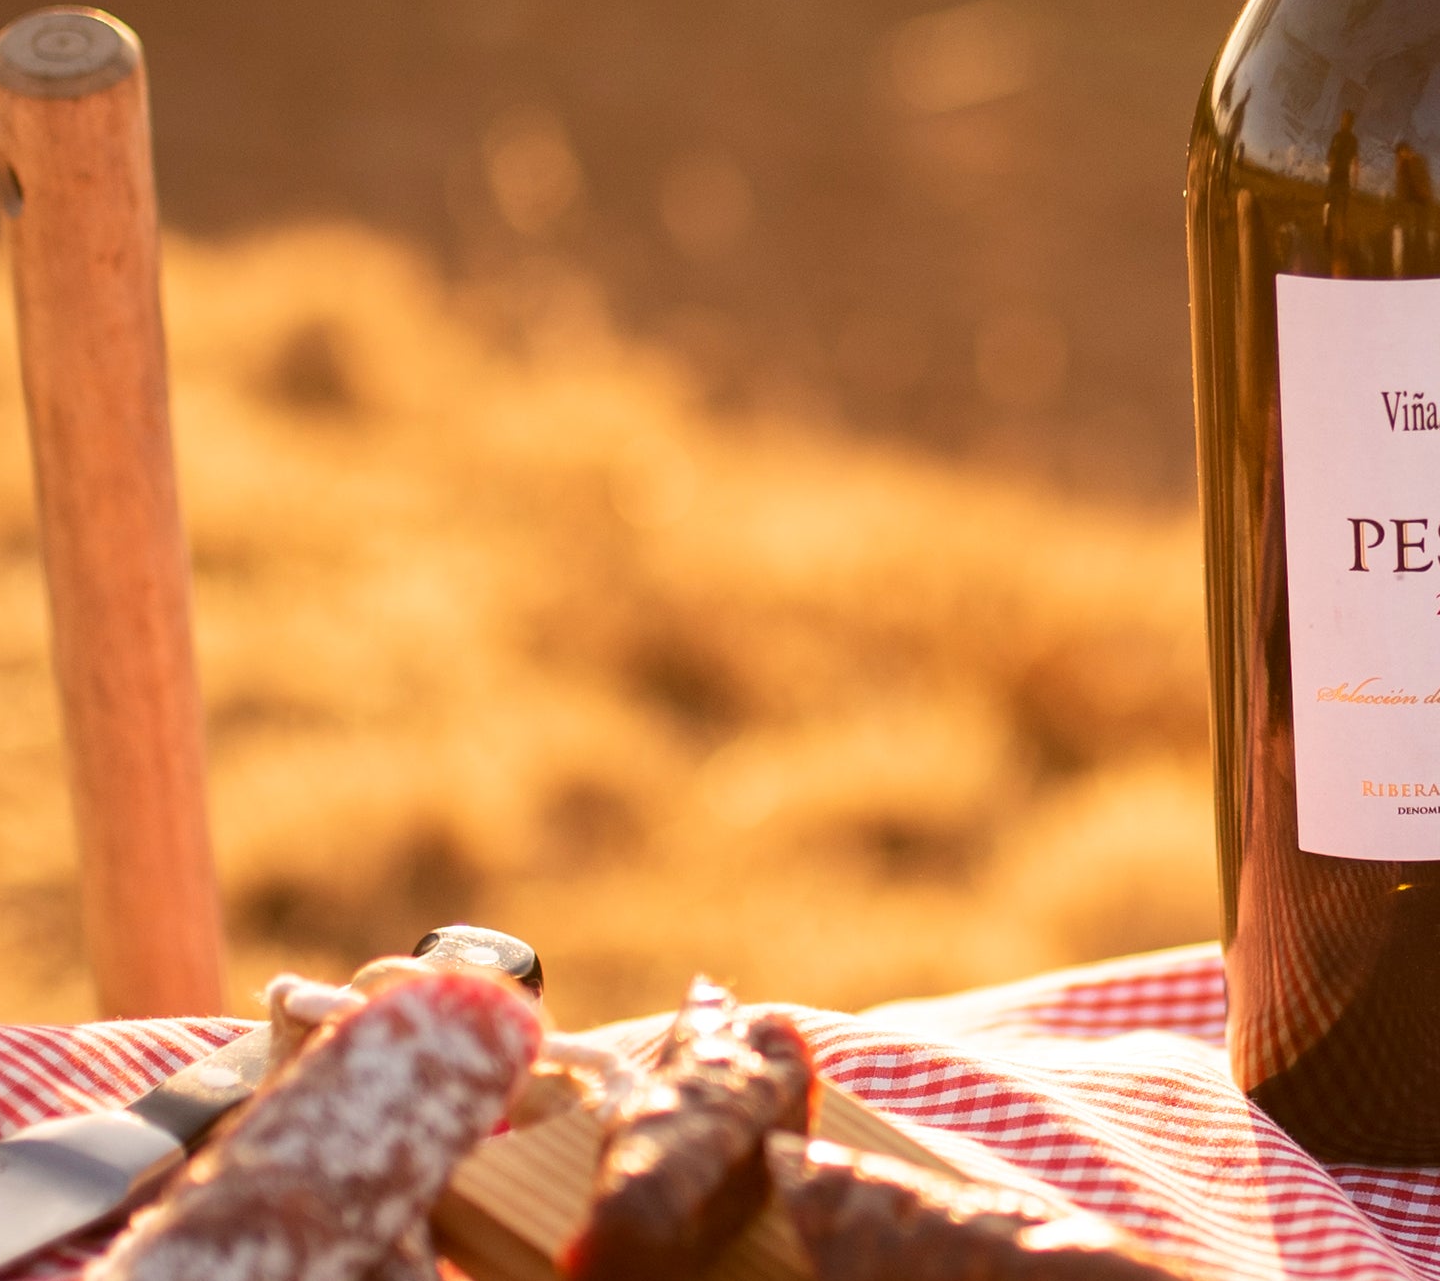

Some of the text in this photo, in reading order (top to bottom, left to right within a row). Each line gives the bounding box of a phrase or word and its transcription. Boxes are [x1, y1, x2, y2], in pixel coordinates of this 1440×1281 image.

[1381, 390, 1440, 432] Viña
[1317, 677, 1418, 705] Selección
[1361, 779, 1440, 798] RIBERA
